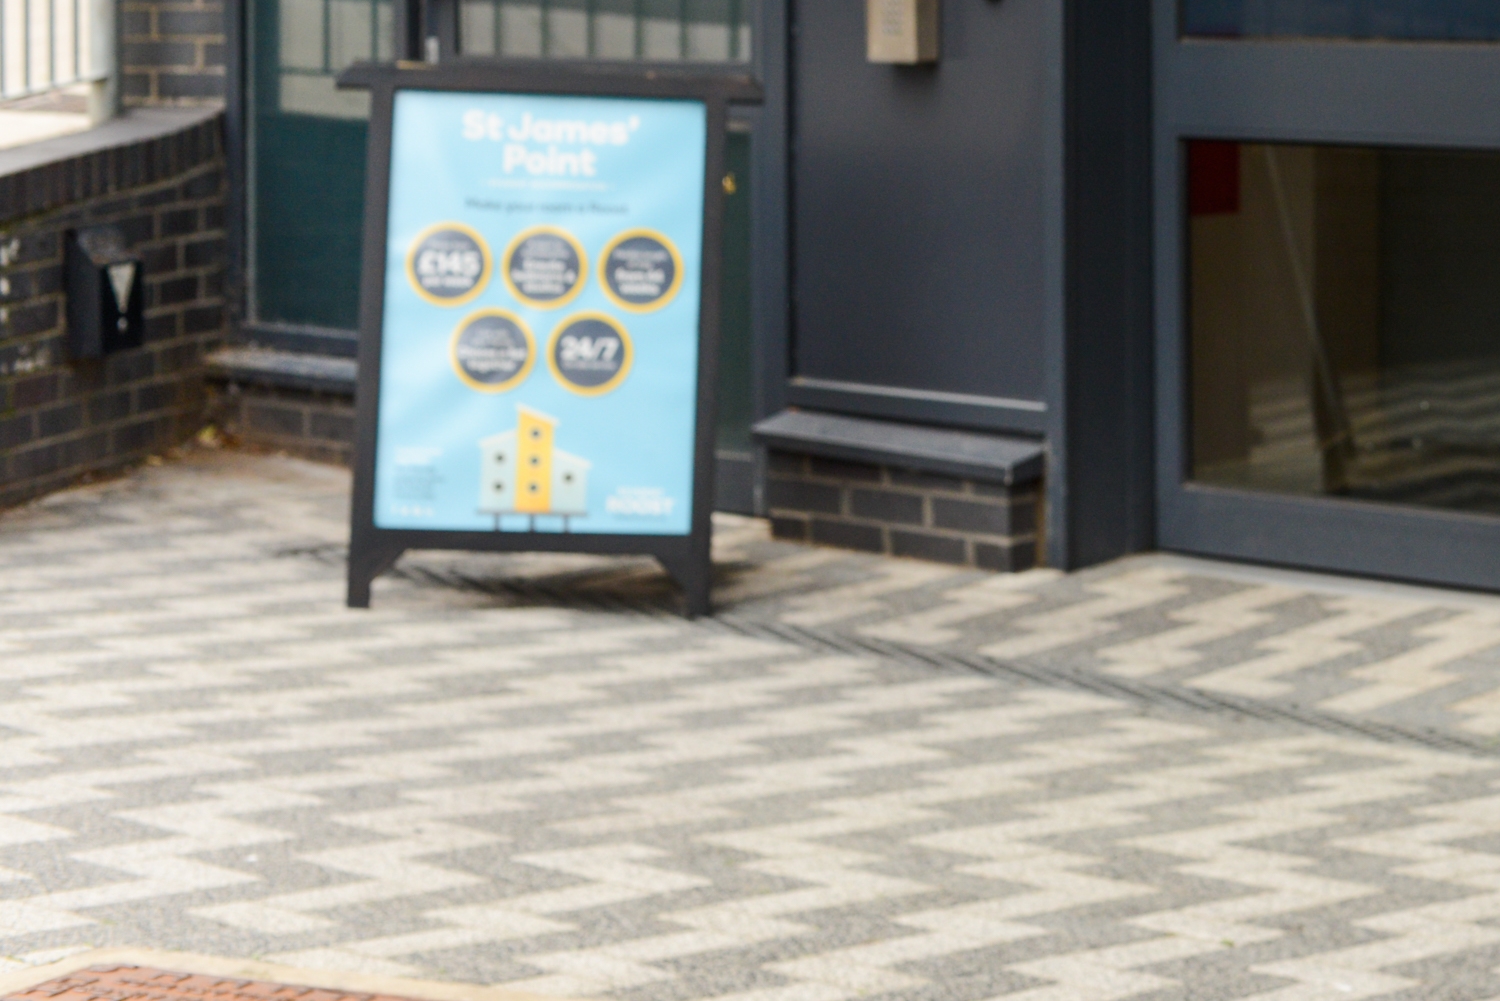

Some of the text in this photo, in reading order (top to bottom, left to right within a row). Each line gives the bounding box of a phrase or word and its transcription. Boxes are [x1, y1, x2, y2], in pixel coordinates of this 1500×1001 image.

[462, 109, 503, 141] St
[503, 144, 597, 176] Point
[560, 336, 620, 362] 24/7
